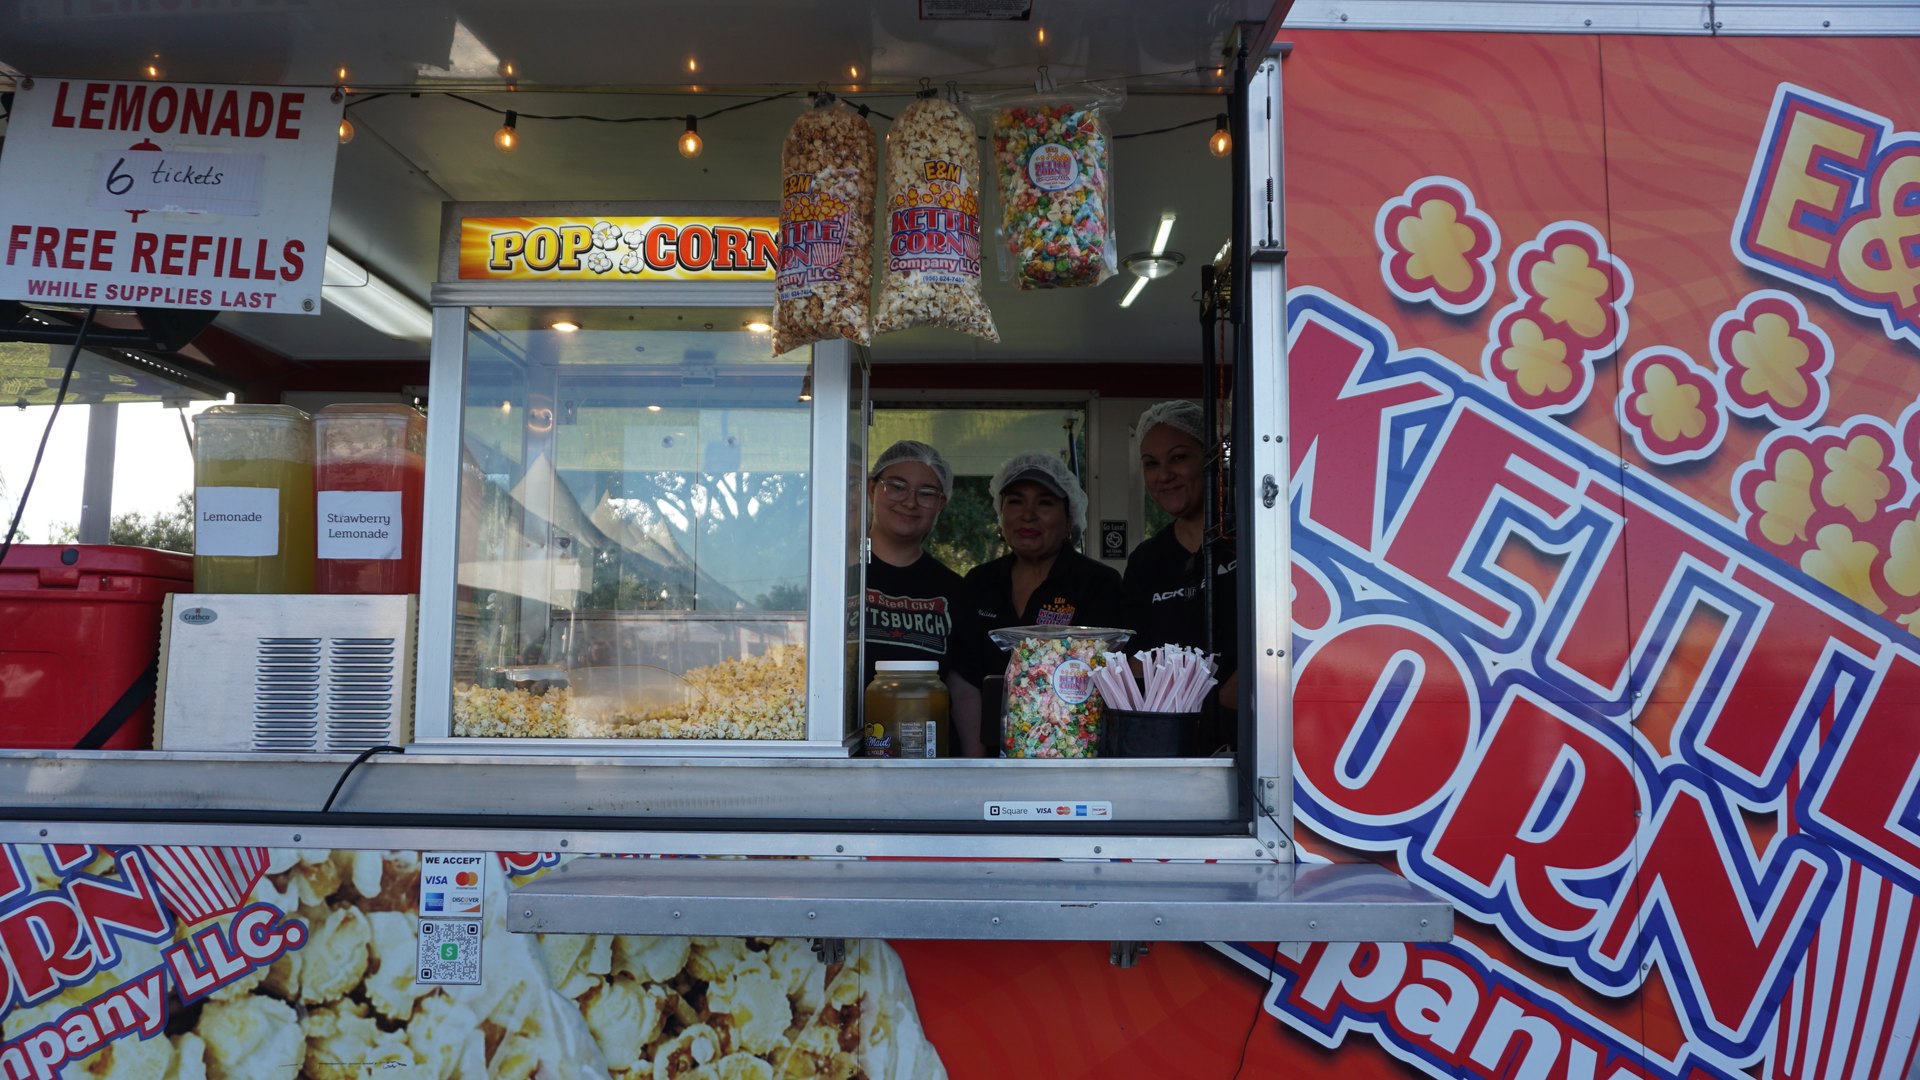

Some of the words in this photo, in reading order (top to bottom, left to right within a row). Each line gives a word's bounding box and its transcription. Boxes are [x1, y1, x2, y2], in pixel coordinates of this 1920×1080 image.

[51, 81, 305, 140] LEMONADE
[106, 157, 135, 196] 6
[151, 159, 224, 186] tickets
[924, 161, 962, 184] E&M
[783, 174, 813, 198] E&M
[892, 206, 980, 239] KETTLE
[6, 224, 117, 272] FREE
[130, 231, 305, 282] REFILLS
[490, 225, 594, 271] POP
[644, 224, 782, 272] CORN
[890, 230, 964, 257] CORN
[806, 267, 841, 283] LLC.
[890, 256, 958, 273] Company
[27, 279, 98, 300] WHILE
[105, 283, 212, 306] SUPPLIES
[220, 290, 277, 309] LAST
[203, 511, 263, 523] Lemonade
[327, 512, 391, 531] Strawberry
[328, 528, 389, 540] Lemonade
[878, 594, 909, 609] Steel
[865, 606, 946, 637] TSBURGH
[1001, 807, 1028, 815] Square
[425, 856, 440, 864] WE
[443, 857, 481, 865] ACCEPT
[425, 875, 448, 885] VISA
[170, 909, 301, 996] LLC.
